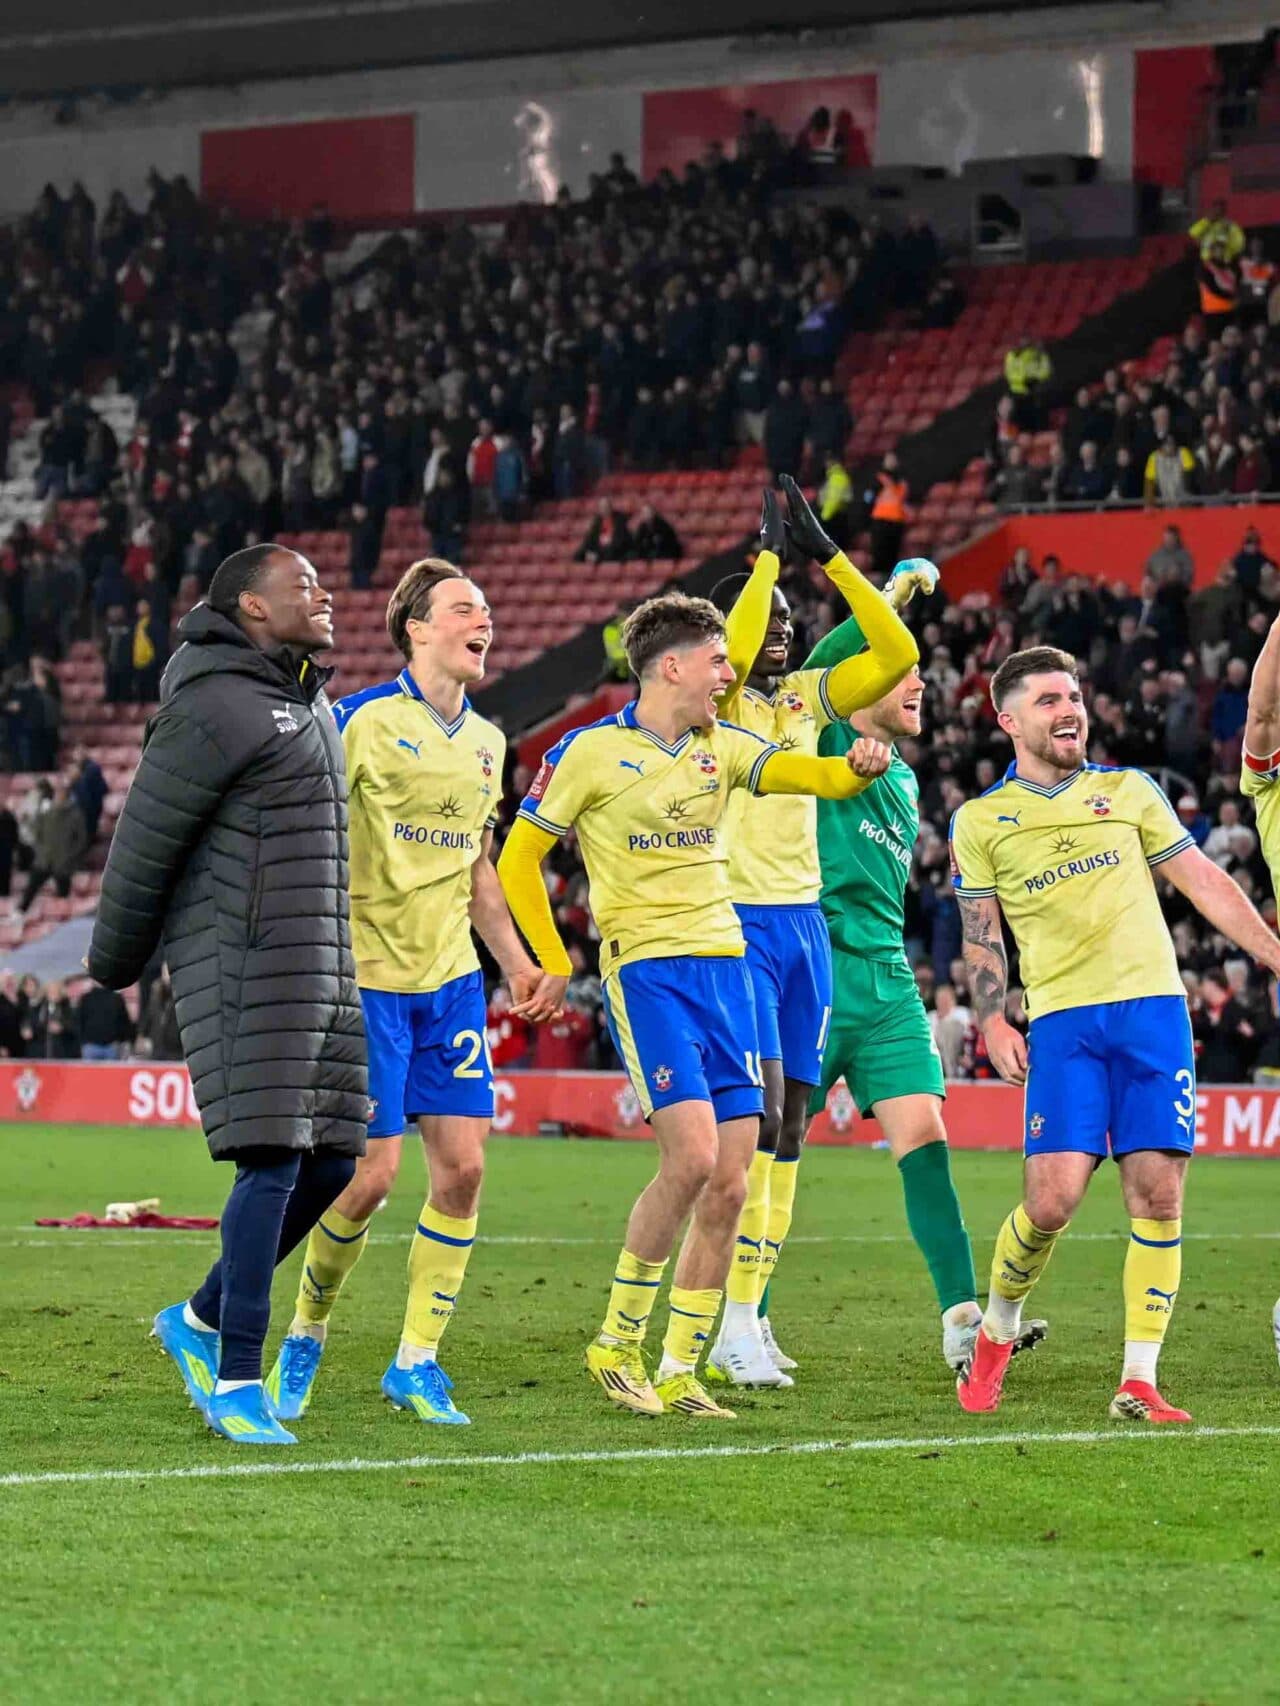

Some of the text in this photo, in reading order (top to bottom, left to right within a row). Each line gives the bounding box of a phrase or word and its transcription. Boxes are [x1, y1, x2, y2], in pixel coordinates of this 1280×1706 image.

[393, 822, 427, 844] P&O
[629, 833, 662, 851] P&O
[1024, 849, 1120, 894] P&O CRUISES
[453, 1025, 494, 1078] 2
[1174, 1068, 1194, 1117] 3
[738, 1254, 760, 1264] SFC
[1145, 1303, 1170, 1314] SFC
